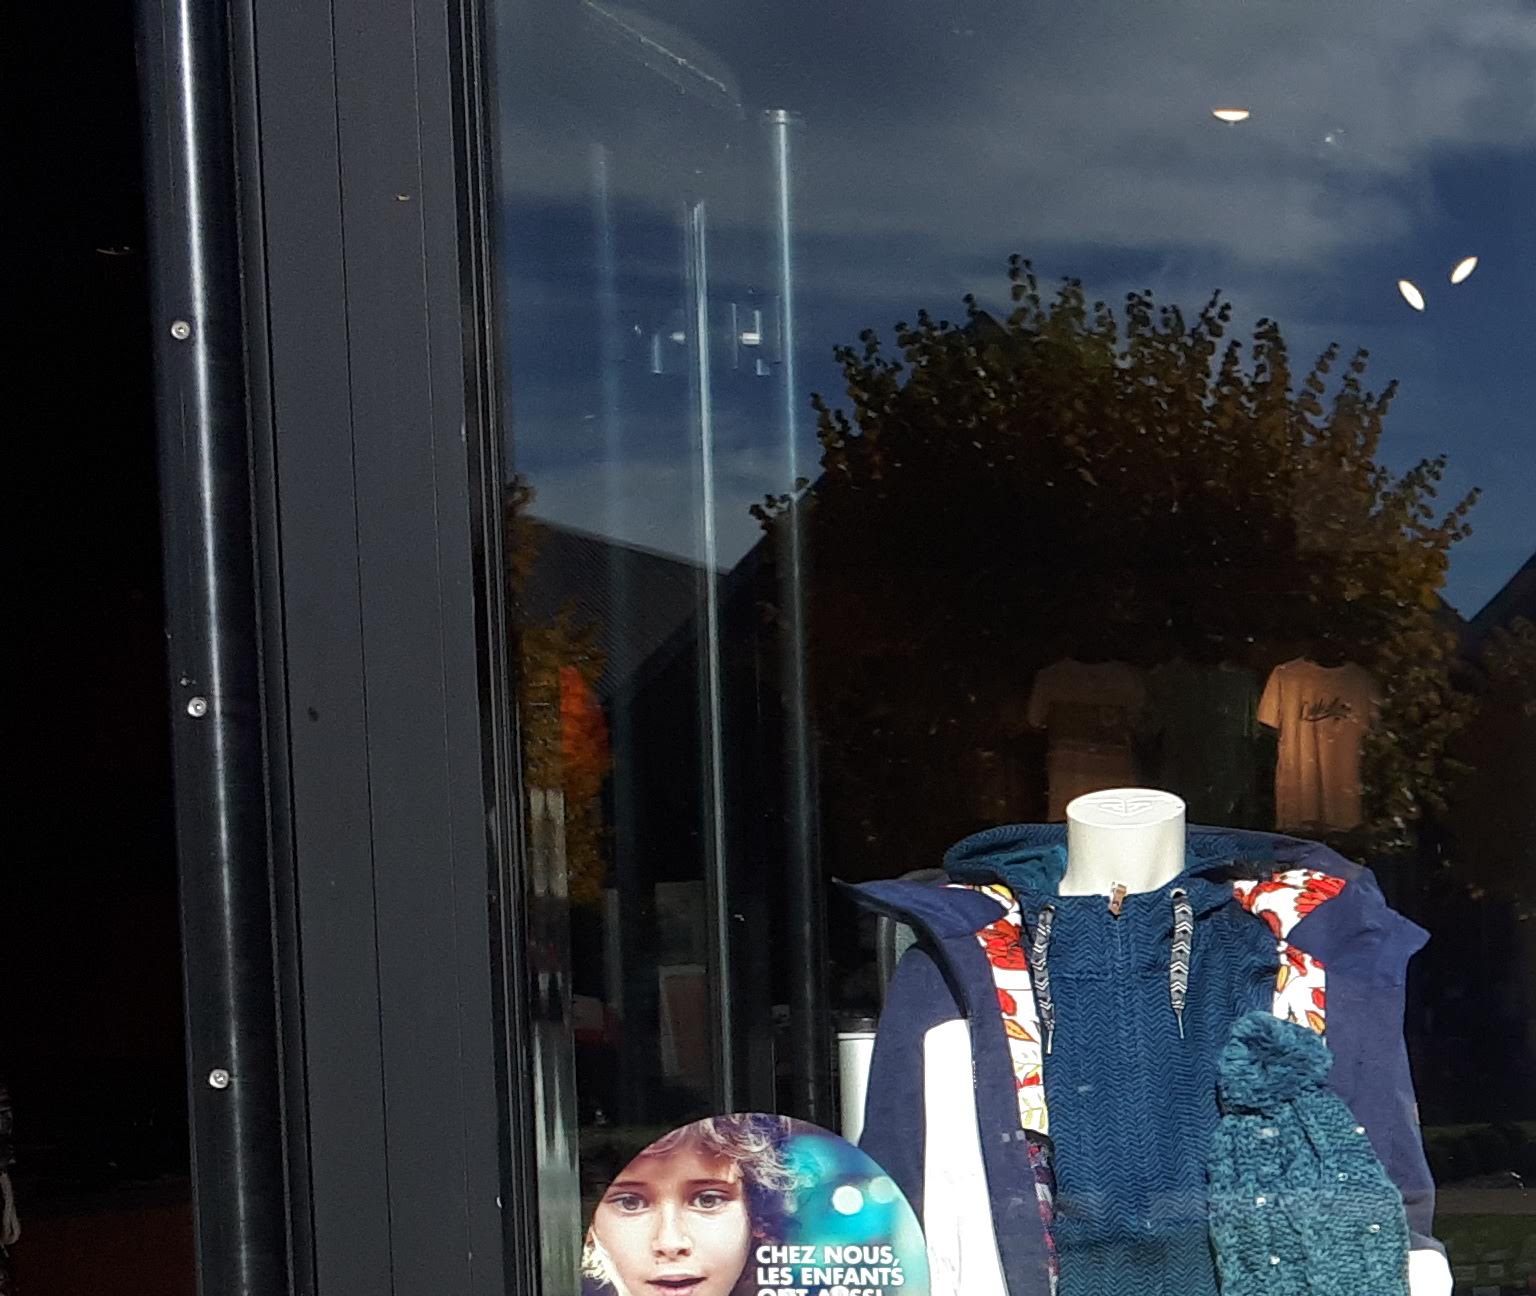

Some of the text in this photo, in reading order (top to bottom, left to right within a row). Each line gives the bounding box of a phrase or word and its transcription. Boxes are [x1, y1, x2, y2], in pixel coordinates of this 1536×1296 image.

[755, 1245, 901, 1267] CHEZ NOUS,
[756, 1267, 905, 1286] LES ENFANTS
